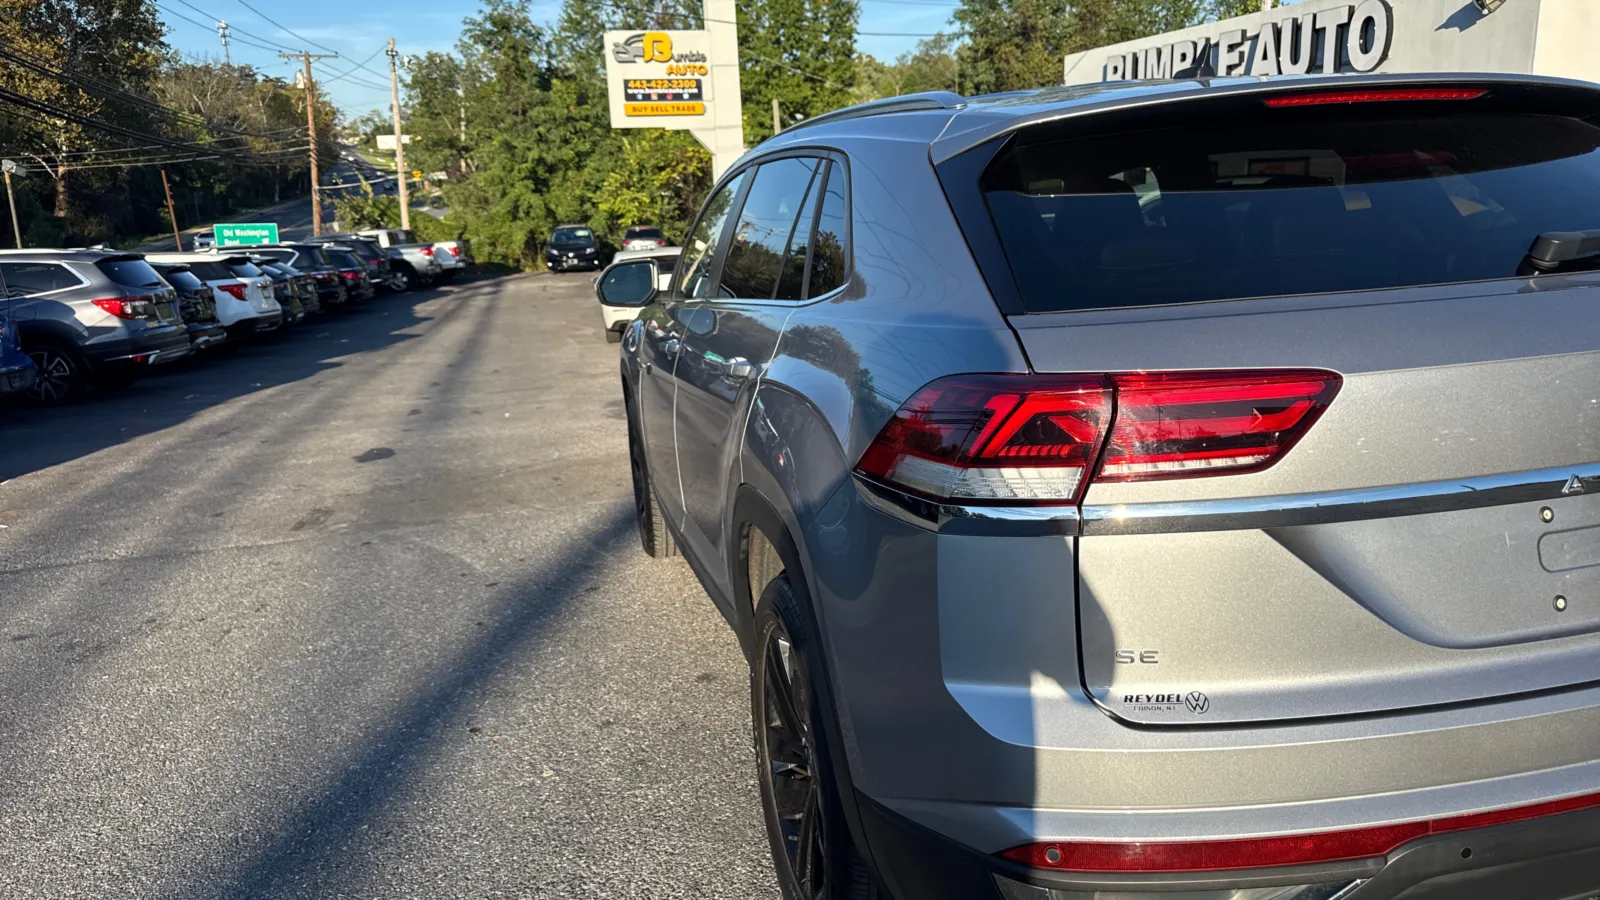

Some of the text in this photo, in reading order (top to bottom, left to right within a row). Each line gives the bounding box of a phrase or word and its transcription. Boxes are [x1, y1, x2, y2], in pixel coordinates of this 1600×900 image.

[666, 64, 708, 76] AUTO
[628, 80, 697, 88] 443-422-2300
[223, 229, 269, 238] Old Washington
[1115, 650, 1159, 664] SE
[1123, 693, 1184, 703] REYDEL
